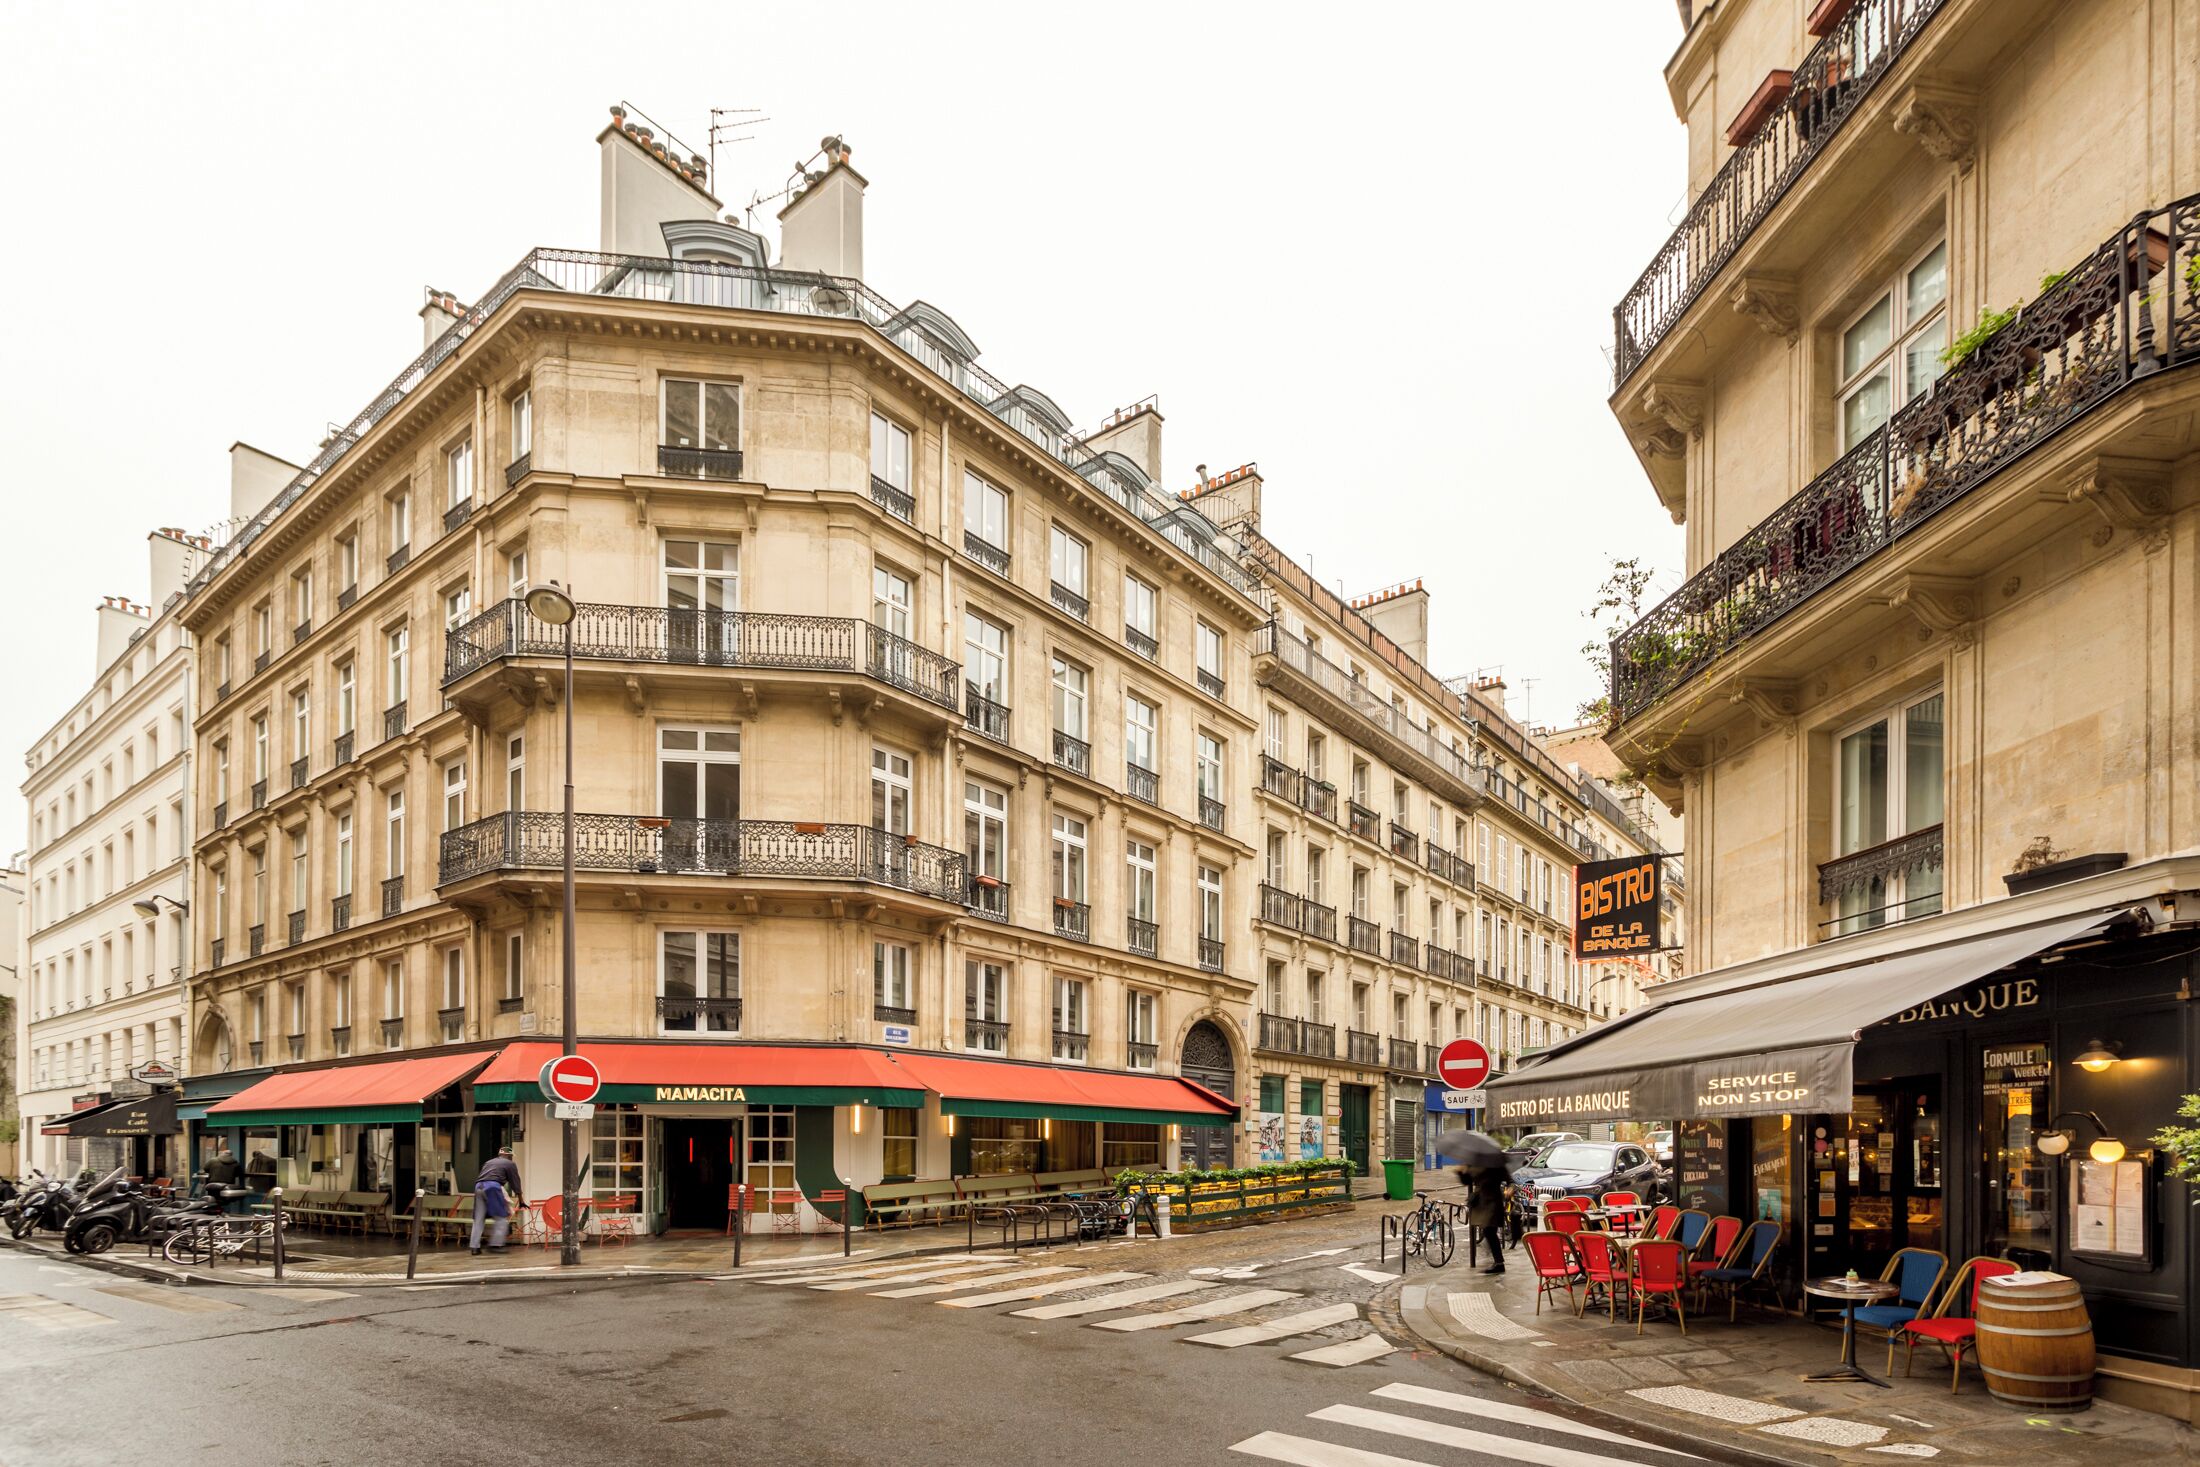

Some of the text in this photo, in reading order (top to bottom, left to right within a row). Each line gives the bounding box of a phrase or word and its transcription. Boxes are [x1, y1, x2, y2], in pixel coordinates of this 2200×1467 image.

[1580, 863, 1655, 921] BISTRO
[1591, 922, 1643, 938] DE LA
[1582, 934, 1651, 952] BANQUE
[1983, 1049, 2034, 1069] FORMULE
[1707, 1071, 1797, 1090] SERVICE
[656, 1087, 746, 1101] MAMACITA
[1447, 1096, 1469, 1104] SAUF
[1698, 1088, 1809, 1107] NON STOP
[1500, 1090, 1630, 1118] BISTRO DE LA BANQUE
